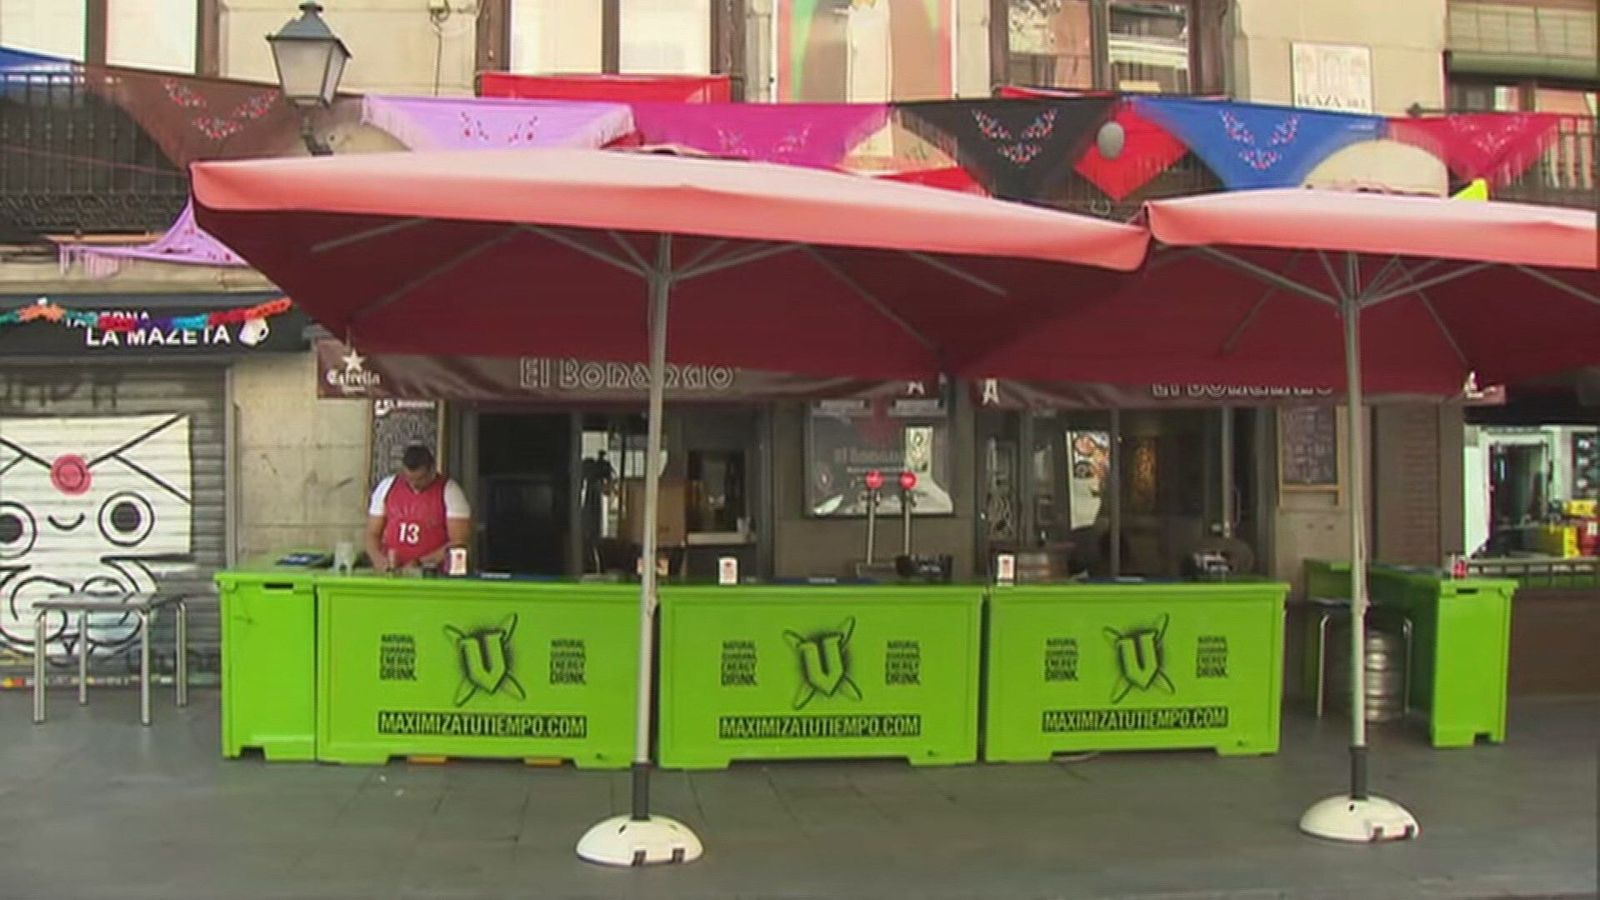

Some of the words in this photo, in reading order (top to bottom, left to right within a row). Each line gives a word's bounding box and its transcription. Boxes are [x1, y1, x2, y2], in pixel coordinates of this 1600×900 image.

[86, 327, 119, 346] LA
[127, 323, 231, 345] MAZETA
[398, 522, 421, 544] 13
[380, 711, 585, 738] MAXIMIZATUTIEMPO.COM
[722, 716, 918, 737] MAXIMIZATUTIEMPO.COM
[1045, 708, 1227, 731] MAXIMIZATUTIEMPO.COM
